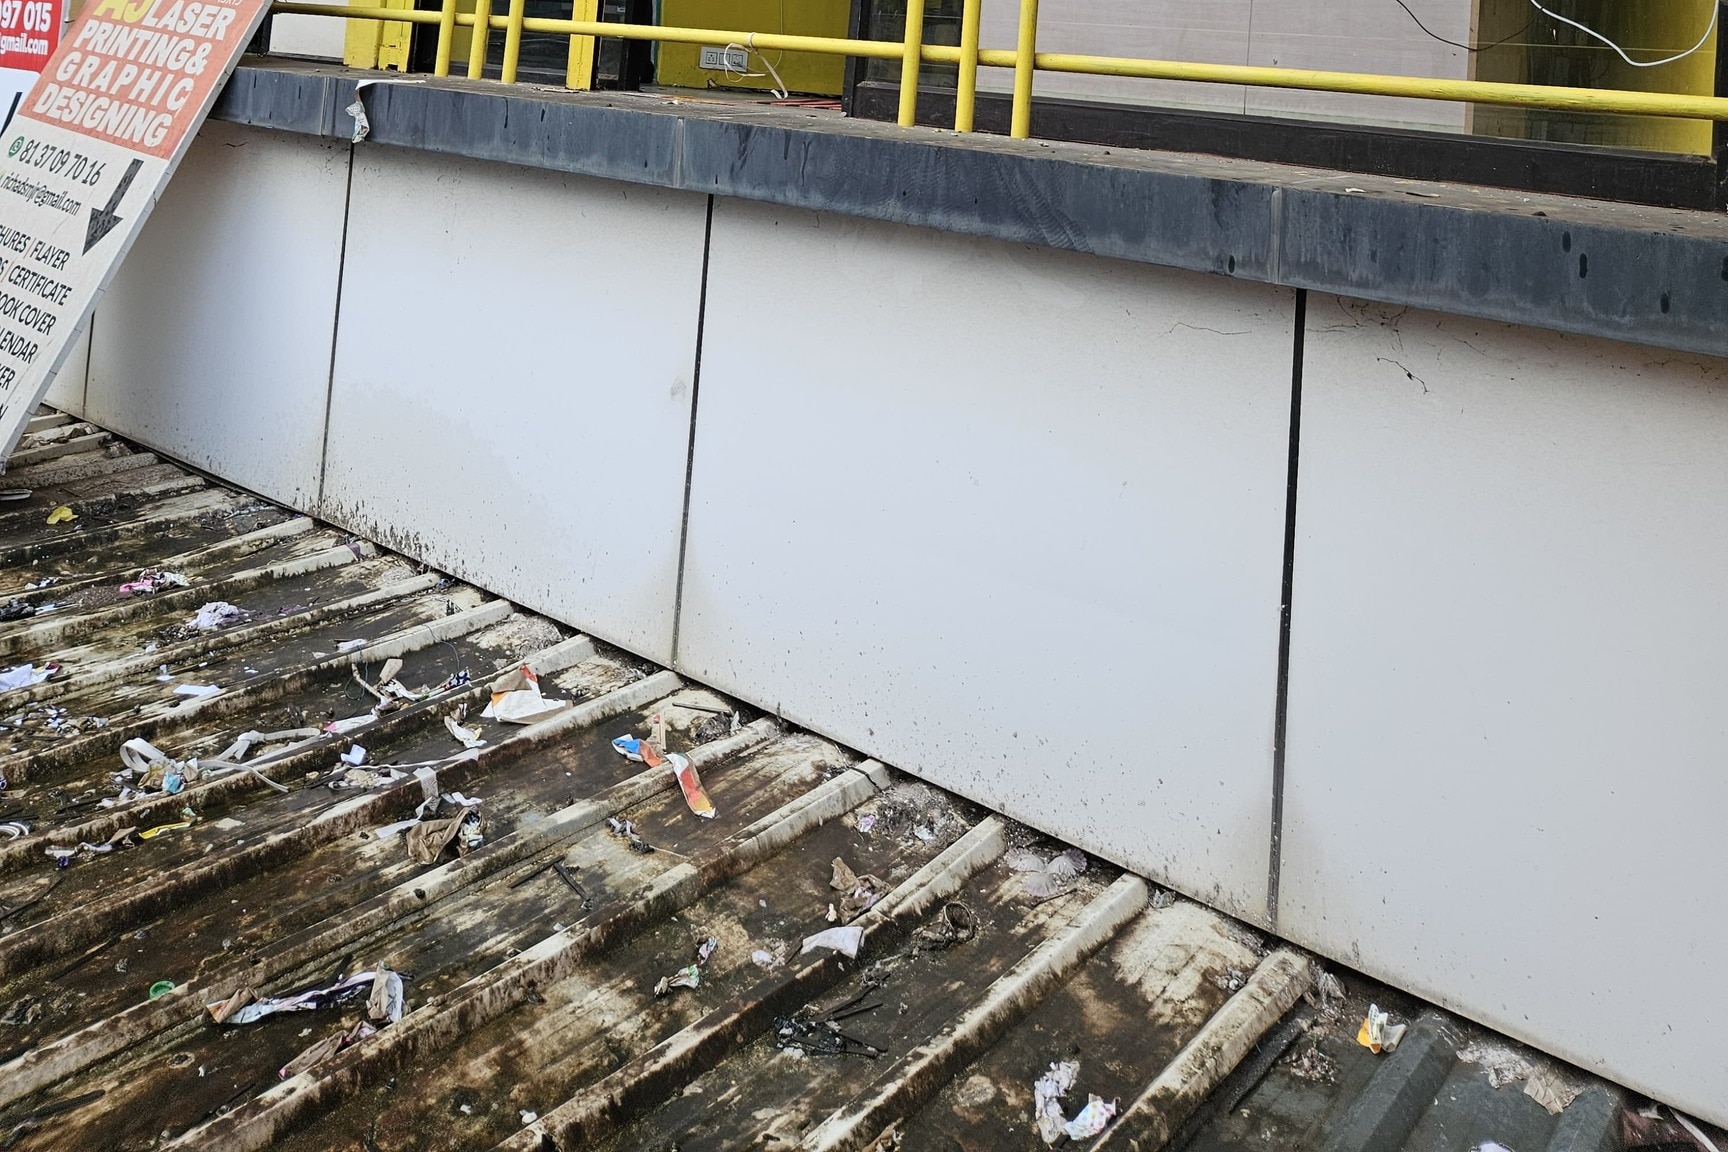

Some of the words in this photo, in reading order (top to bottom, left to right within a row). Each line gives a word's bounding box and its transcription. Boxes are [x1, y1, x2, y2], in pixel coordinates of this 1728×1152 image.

[24, 0, 53, 32] 015
[56, 51, 195, 111] GRAPHIC
[32, 82, 173, 147] DESIGNING
[29, 240, 71, 271] FLAYER
[8, 264, 73, 306] CERTIFICATE
[18, 304, 57, 336] COVER
